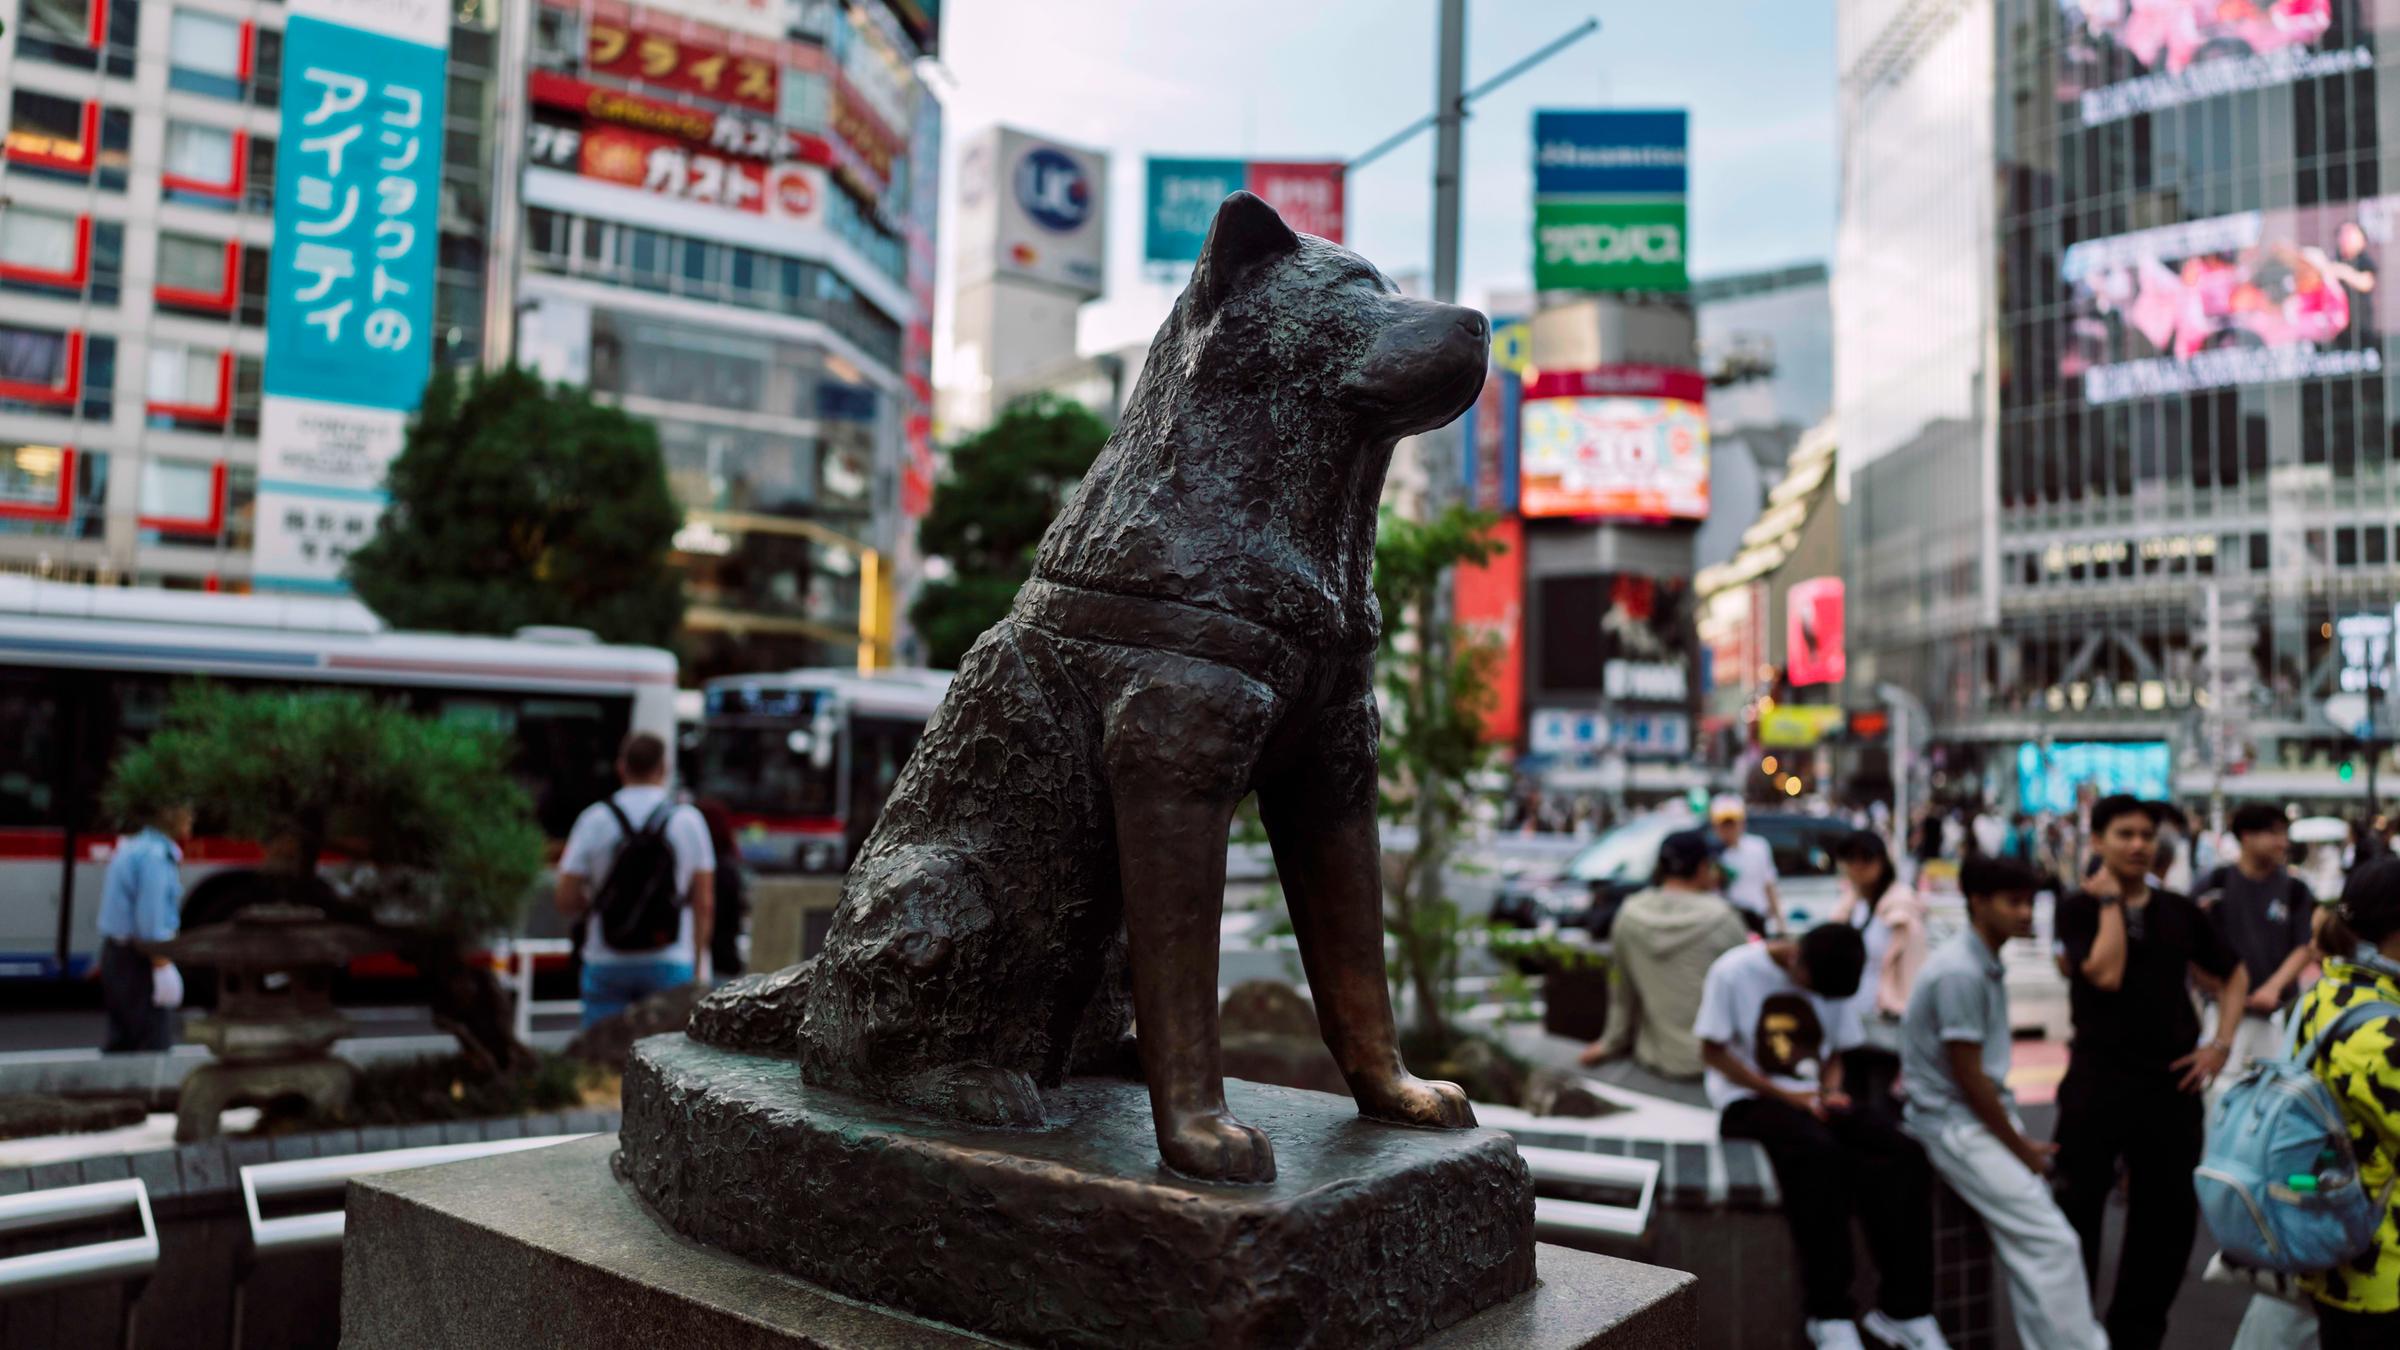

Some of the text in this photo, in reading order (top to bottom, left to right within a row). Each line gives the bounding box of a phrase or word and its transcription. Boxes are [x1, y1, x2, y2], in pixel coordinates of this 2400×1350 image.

[293, 66, 369, 342] アイシティ
[363, 83, 423, 351] コンタクトの
[645, 144, 762, 207] ガスト
